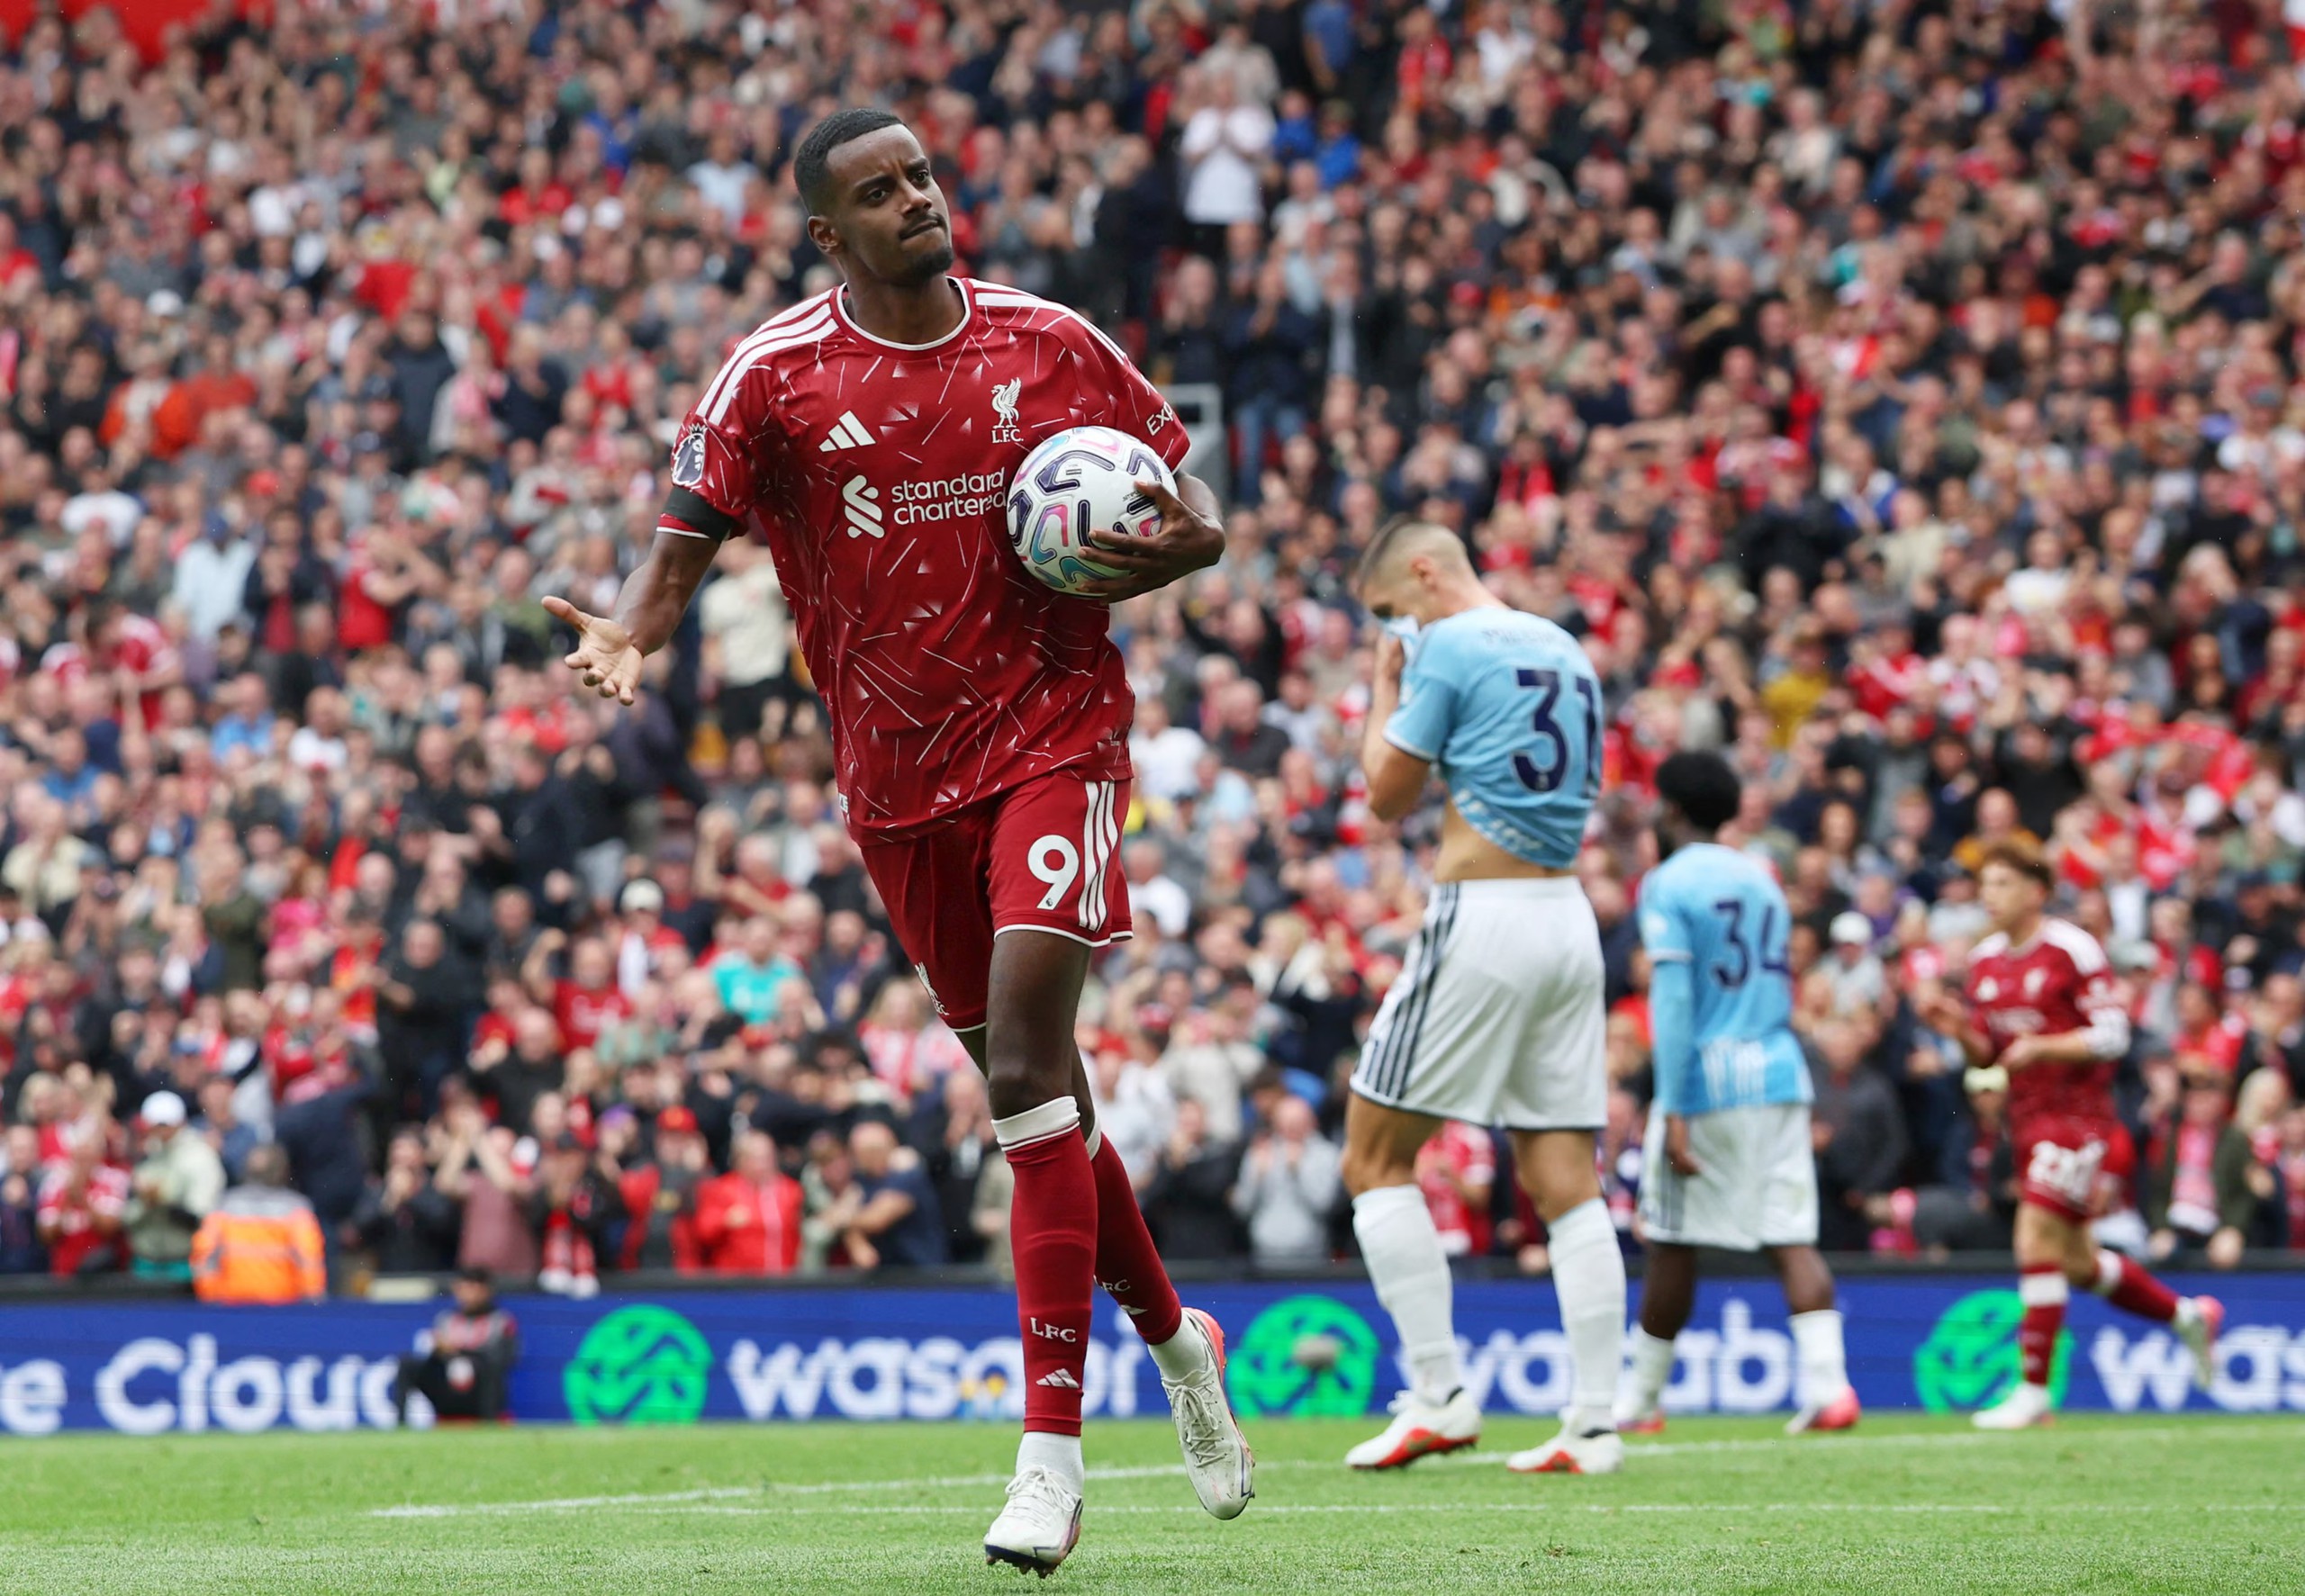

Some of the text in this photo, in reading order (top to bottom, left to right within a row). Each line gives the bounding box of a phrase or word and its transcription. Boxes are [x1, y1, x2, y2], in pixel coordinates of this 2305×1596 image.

[891, 466, 1005, 503] standard
[1513, 668, 1598, 799] 31
[1027, 834, 1079, 910] 9
[1714, 899, 1790, 988] 34
[1030, 1317, 1077, 1343] LFC
